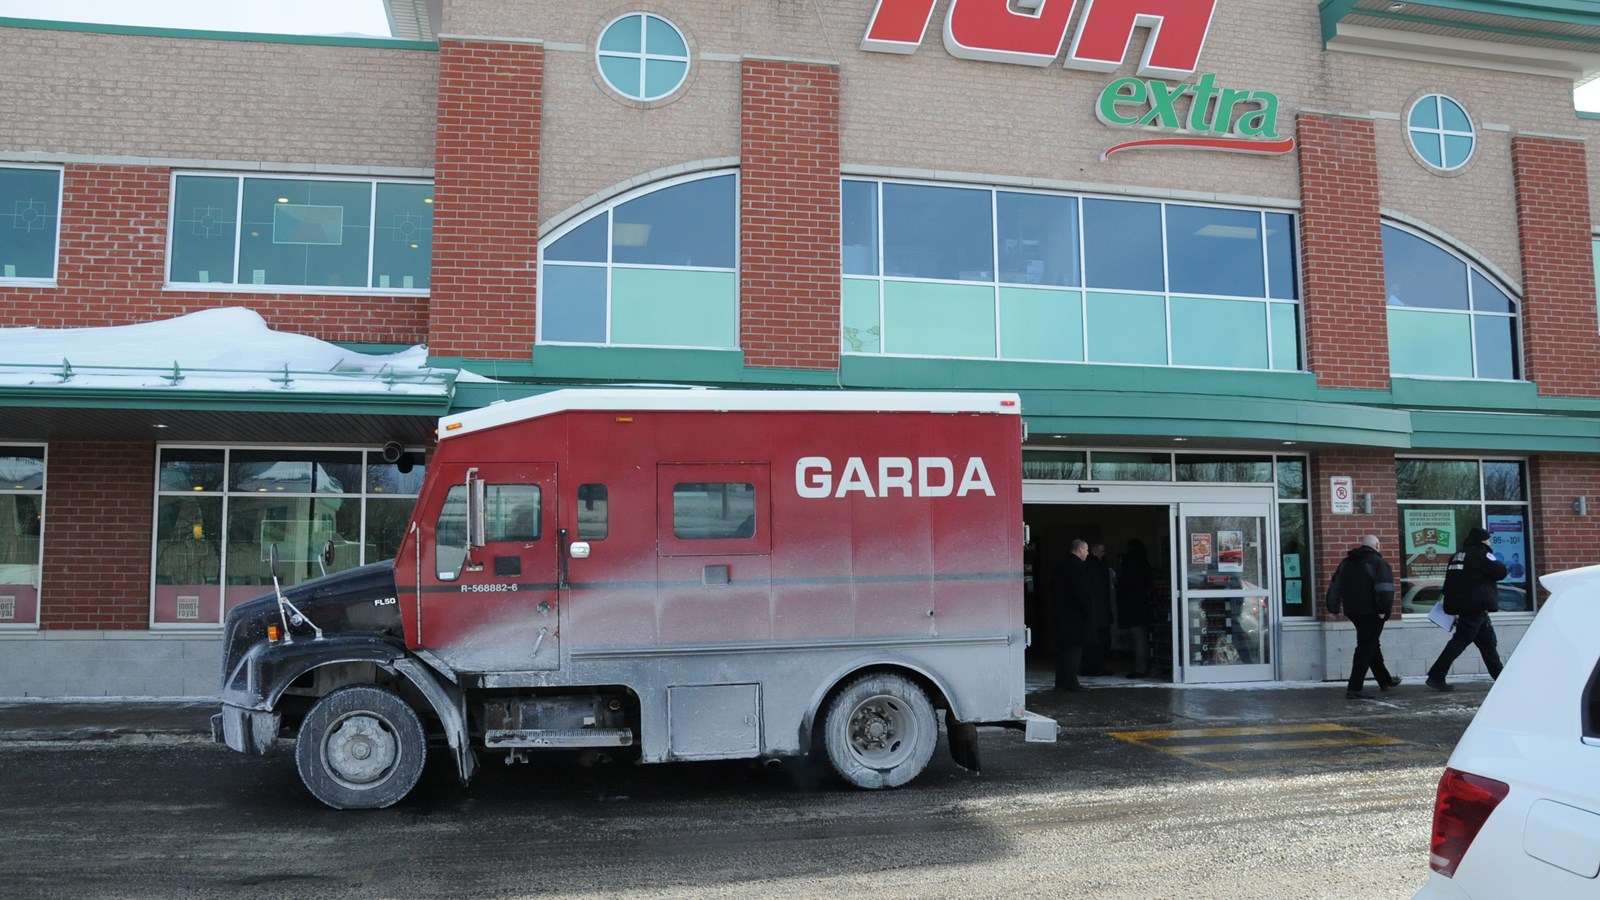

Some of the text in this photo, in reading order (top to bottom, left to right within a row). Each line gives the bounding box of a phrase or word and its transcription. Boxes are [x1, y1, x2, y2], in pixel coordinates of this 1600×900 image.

[1096, 73, 1279, 139] extra
[795, 456, 996, 498] GARDA
[461, 584, 518, 592] R-568882-6
[374, 598, 396, 606] FL50
